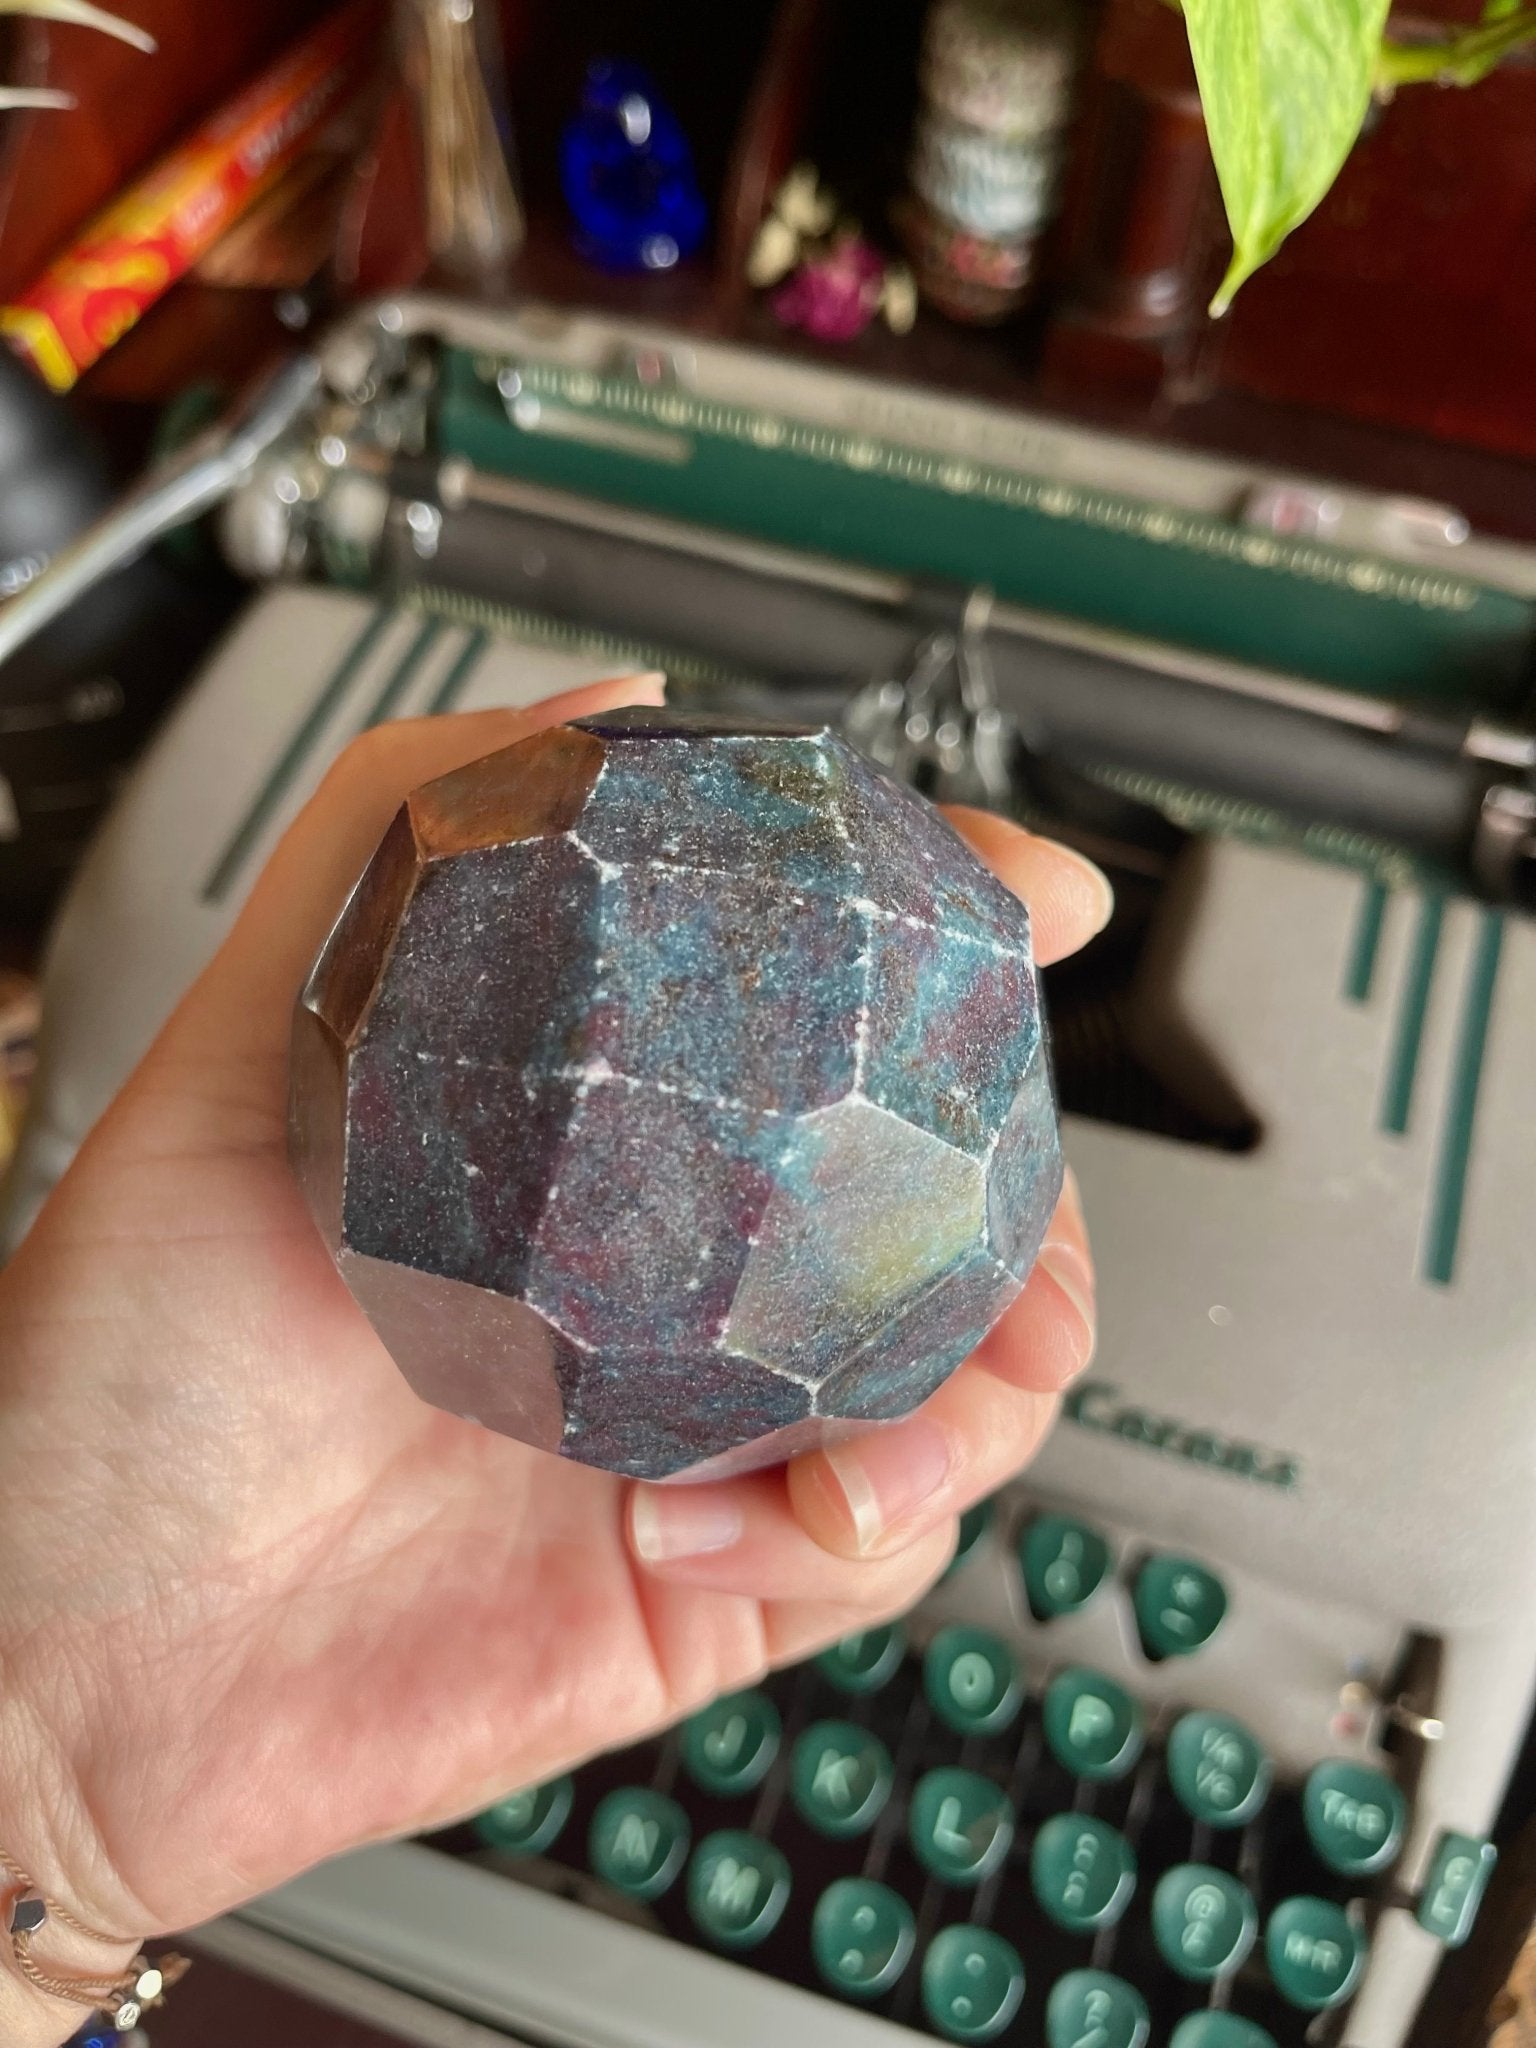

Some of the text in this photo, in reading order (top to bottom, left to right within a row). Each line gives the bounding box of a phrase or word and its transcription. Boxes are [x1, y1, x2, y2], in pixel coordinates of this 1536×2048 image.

[704, 1715, 748, 1766] J
[1069, 1694, 1115, 1747] P
[811, 1748, 860, 1810] K
[932, 1796, 973, 1857] L
[1320, 1788, 1387, 1841] TAB
[707, 1857, 760, 1914] M
[1284, 1930, 1343, 1977] MR
